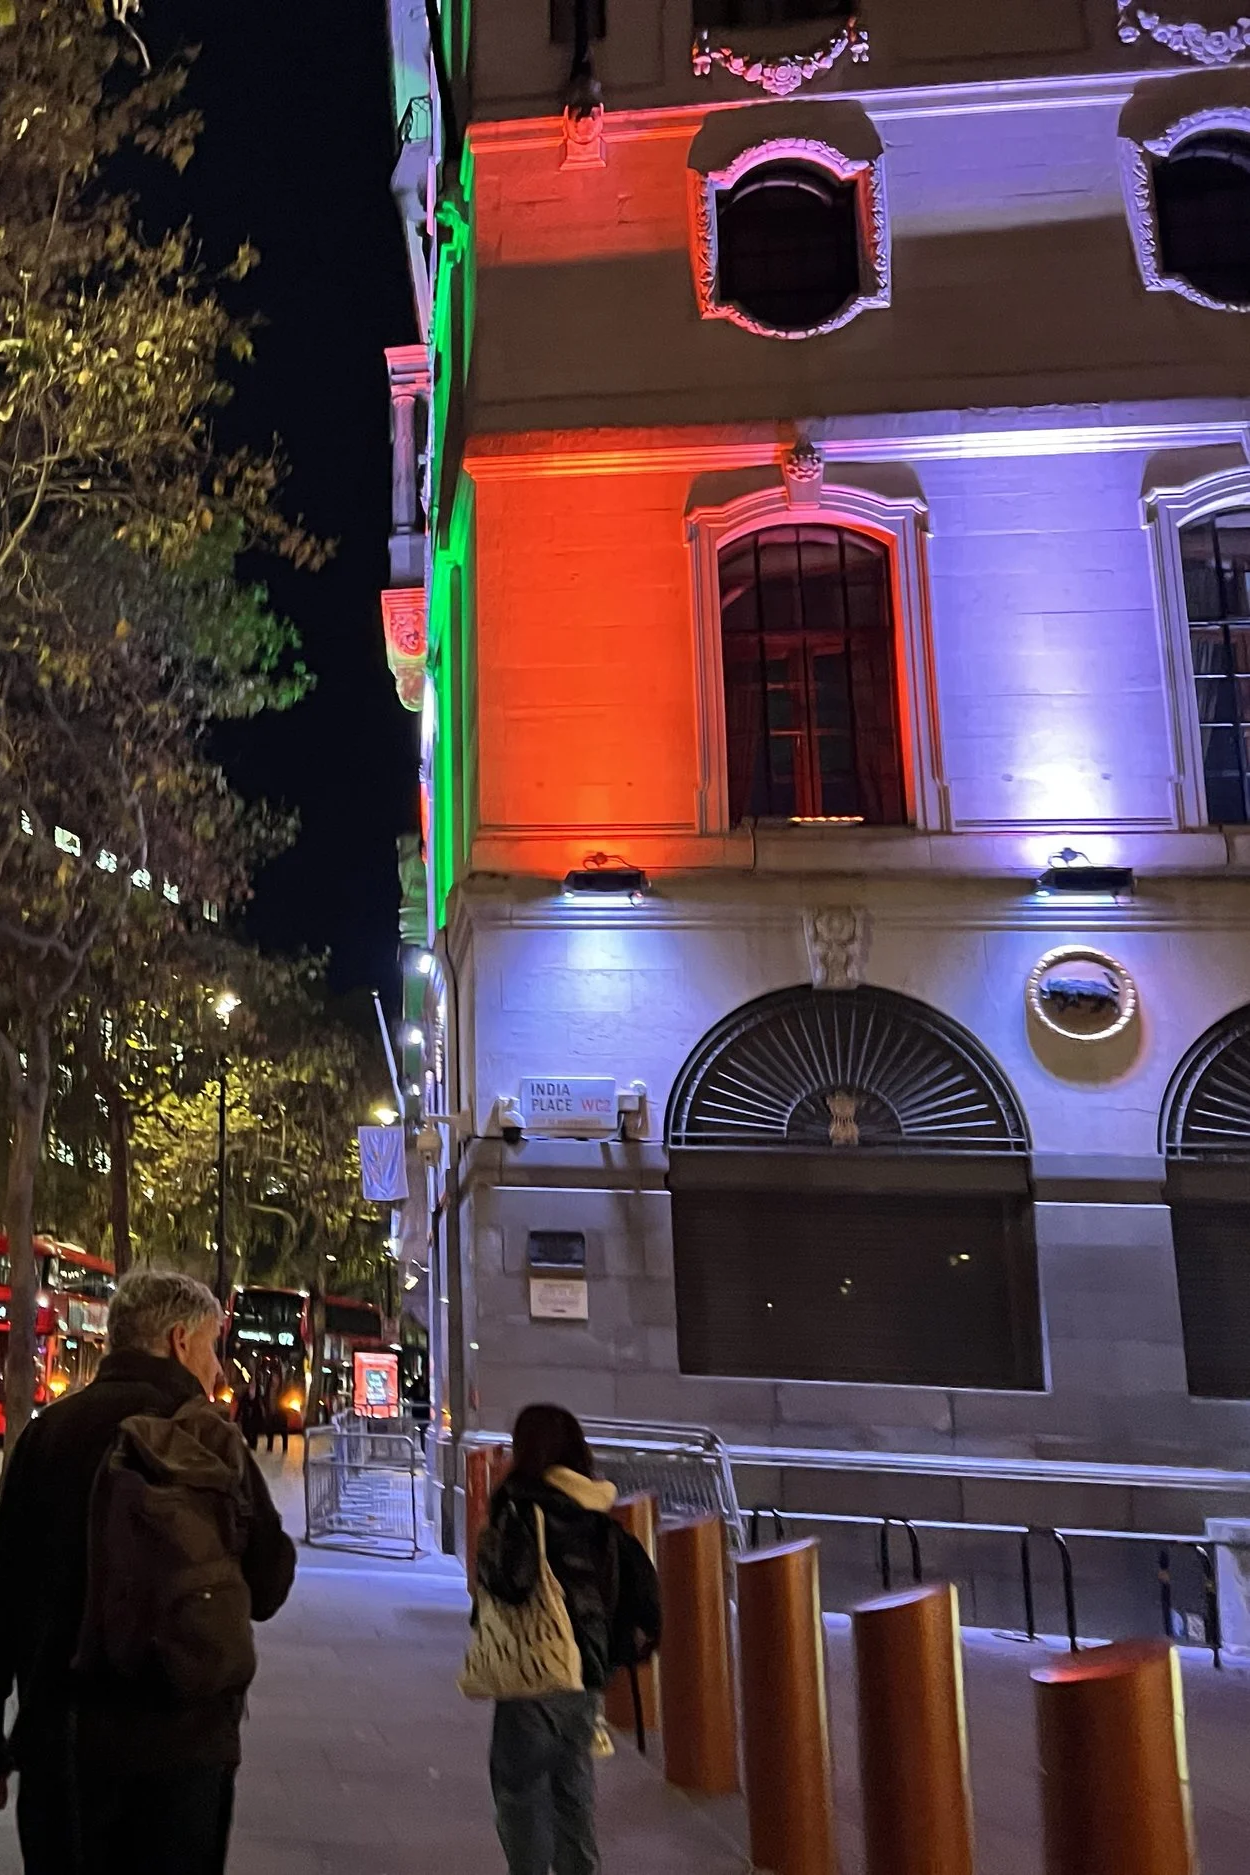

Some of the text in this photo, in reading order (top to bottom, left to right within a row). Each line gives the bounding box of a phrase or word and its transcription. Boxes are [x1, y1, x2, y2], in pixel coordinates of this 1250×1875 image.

[531, 1083, 570, 1096] INDIA
[532, 1099, 611, 1112] PLACE WC2
